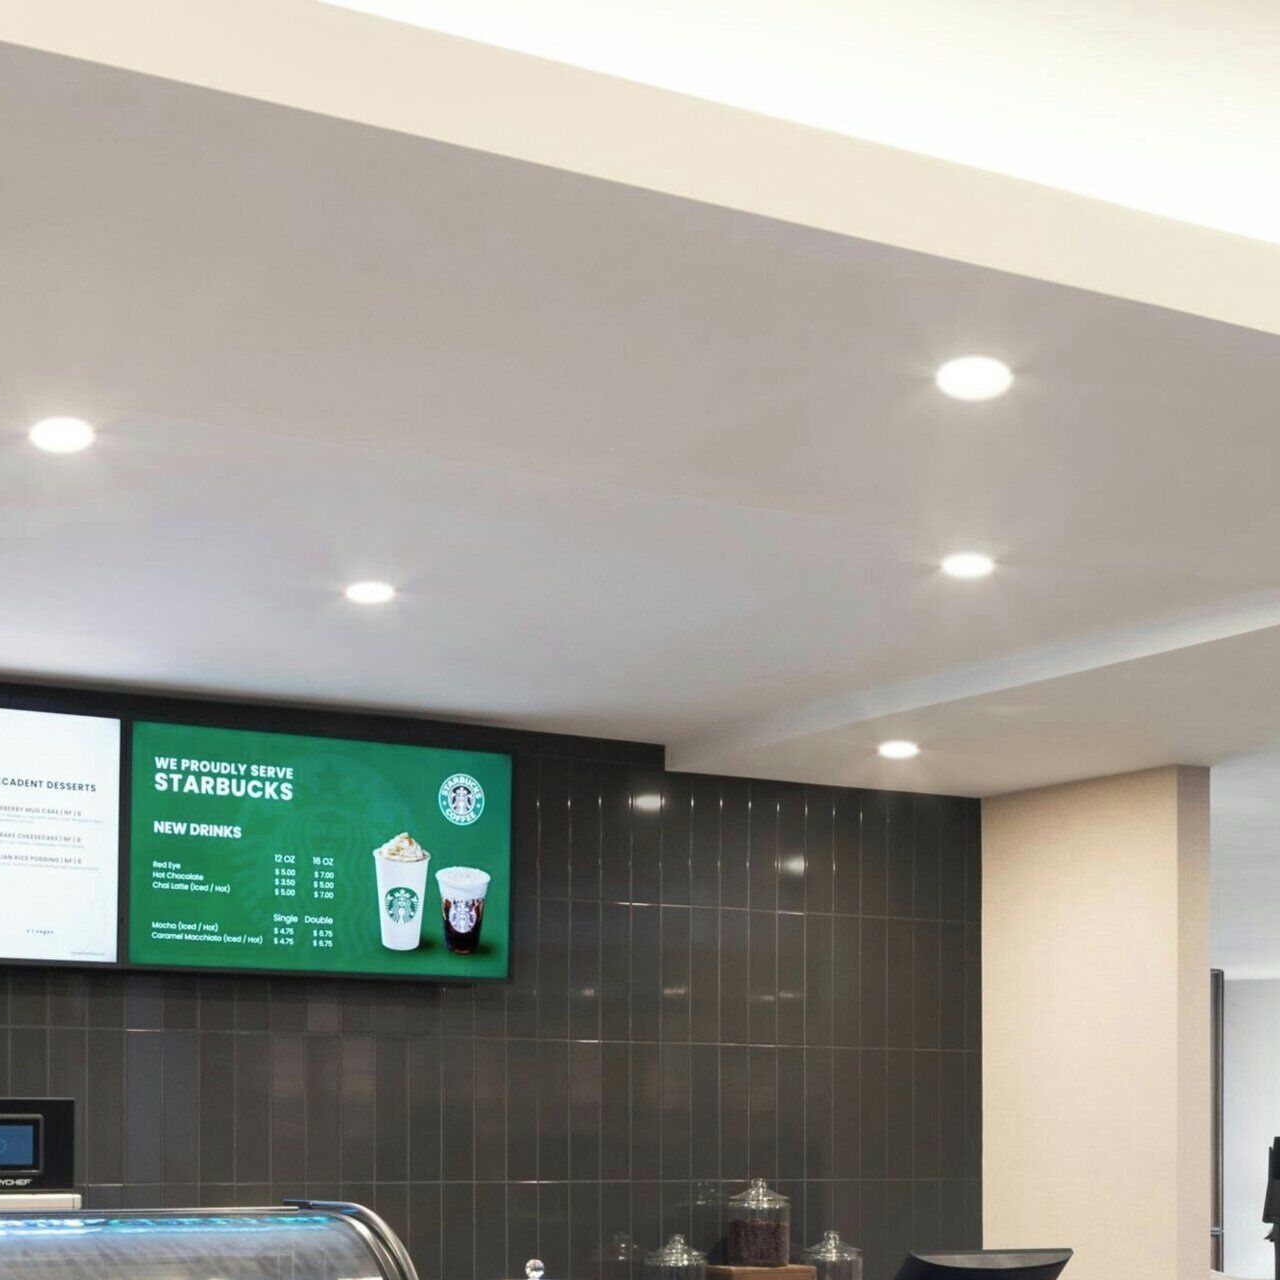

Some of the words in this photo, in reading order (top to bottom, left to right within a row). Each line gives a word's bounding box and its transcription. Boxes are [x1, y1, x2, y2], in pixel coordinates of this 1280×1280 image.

[154, 756, 177, 770] WE
[181, 758, 247, 776] PROUDLY
[250, 764, 294, 779] SERVE
[46, 780, 97, 793] DESSERTS
[154, 772, 293, 801] STARBUCKS
[441, 776, 481, 799] STARBUCKS
[445, 808, 477, 823] COFFEE
[154, 820, 188, 835] NEW
[189, 823, 242, 839] DRINKS
[17, 833, 58, 841] CHEESECAKE
[274, 854, 283, 863] 12
[284, 855, 296, 864] OZ
[312, 856, 321, 865] 16
[322, 857, 334, 866] OZ
[152, 860, 167, 869] Red
[168, 861, 181, 871] Eye
[152, 871, 165, 879] Hot
[166, 872, 204, 881] Chocolate
[280, 869, 296, 877] 5.00
[319, 871, 335, 879] 7.00
[152, 881, 170, 890] Chai
[170, 882, 189, 891] Latte
[190, 883, 209, 892] (Iced
[214, 884, 231, 894] Hot)
[319, 881, 334, 890] 5.00
[280, 889, 296, 897] 5.00
[319, 891, 334, 899] 7.00
[273, 913, 298, 925] Single
[304, 915, 333, 925] Double
[151, 921, 177, 930] Mocha
[178, 921, 197, 931] (Iced
[203, 923, 219, 932] Hot)
[279, 928, 294, 936] 4.75
[151, 932, 184, 940] Caramel
[184, 933, 222, 942] Macchiato
[223, 934, 242, 943] (Iced
[247, 935, 263, 945] Hot)
[279, 938, 294, 946] 4.75
